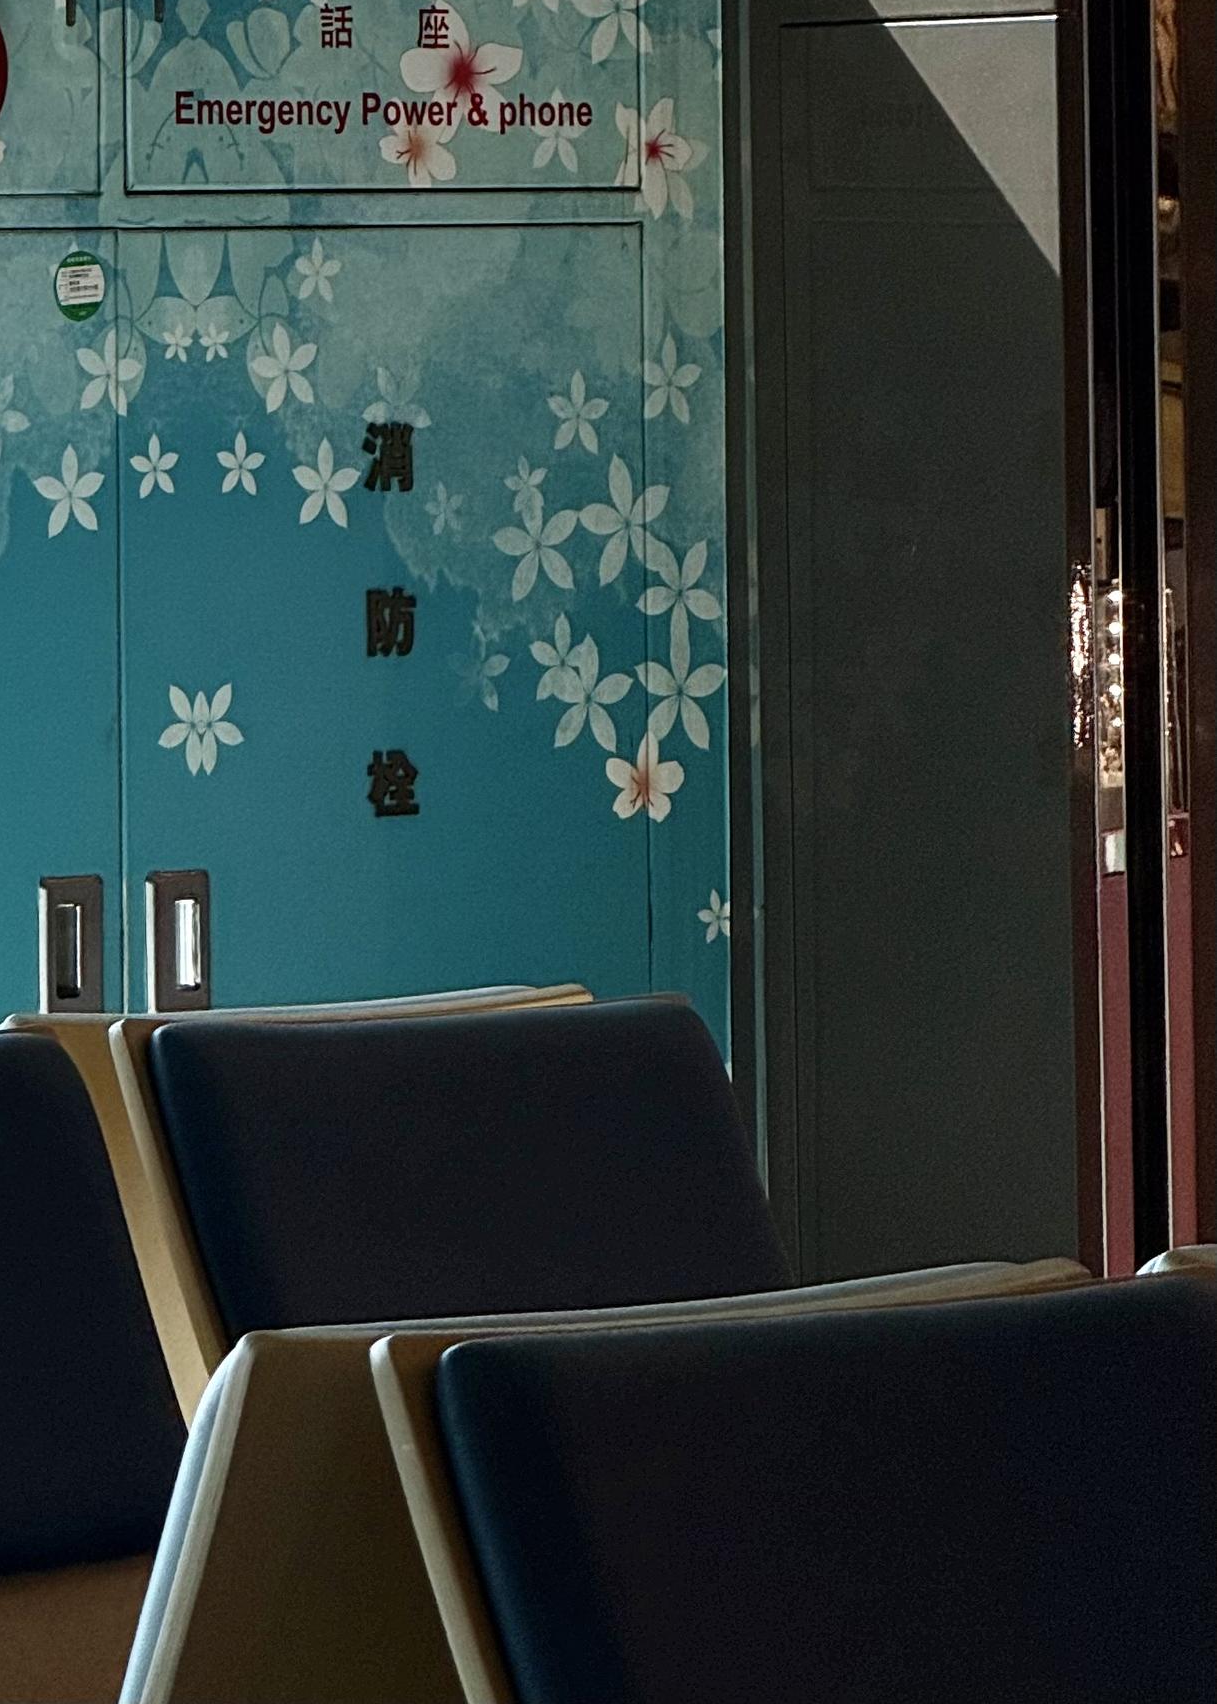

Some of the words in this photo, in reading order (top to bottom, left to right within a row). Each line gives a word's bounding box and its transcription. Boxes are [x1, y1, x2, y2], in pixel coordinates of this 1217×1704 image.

[175, 91, 350, 134] Emergency
[362, 92, 458, 127] Power
[467, 93, 489, 127] &
[500, 93, 593, 134] phone
[361, 421, 420, 817] 消防栓
